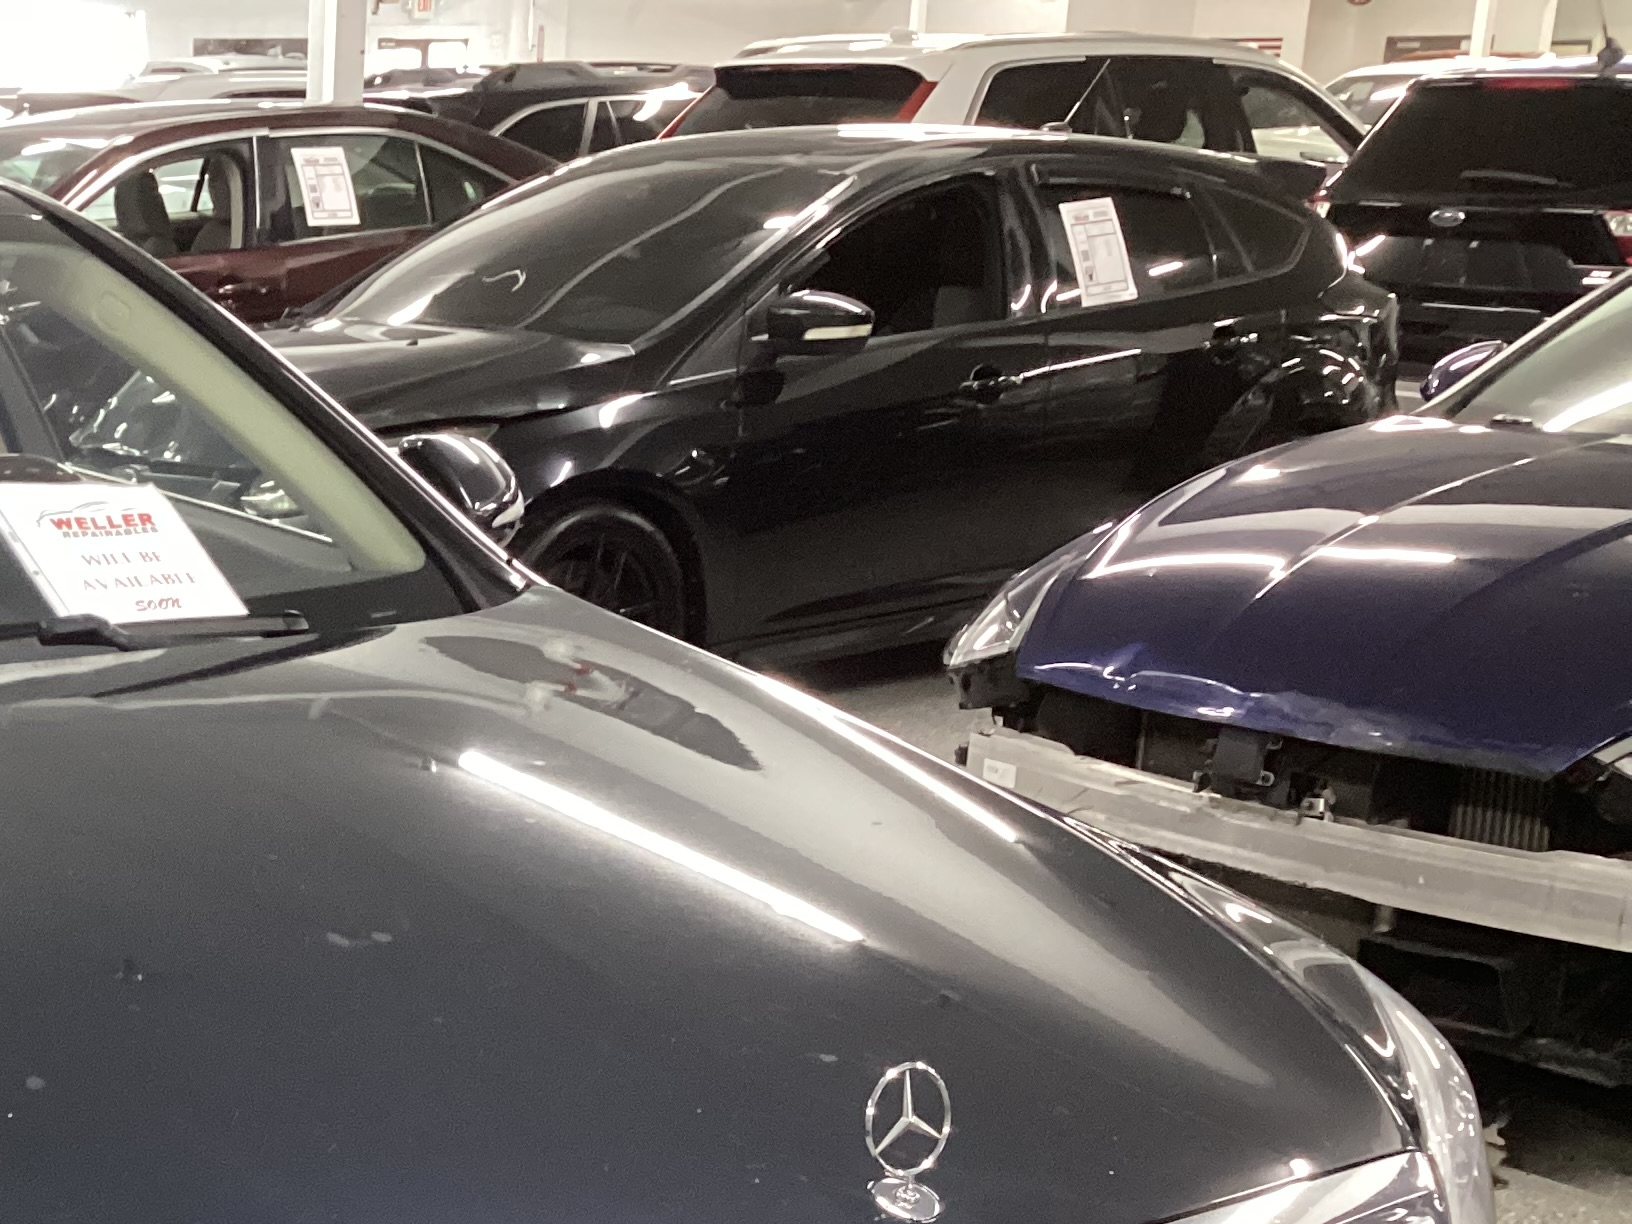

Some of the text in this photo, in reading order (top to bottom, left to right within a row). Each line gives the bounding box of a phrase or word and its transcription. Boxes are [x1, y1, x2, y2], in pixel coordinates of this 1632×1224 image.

[49, 512, 156, 531] WELLER
[62, 525, 159, 538] REPAIRABLES
[139, 551, 162, 563] BE
